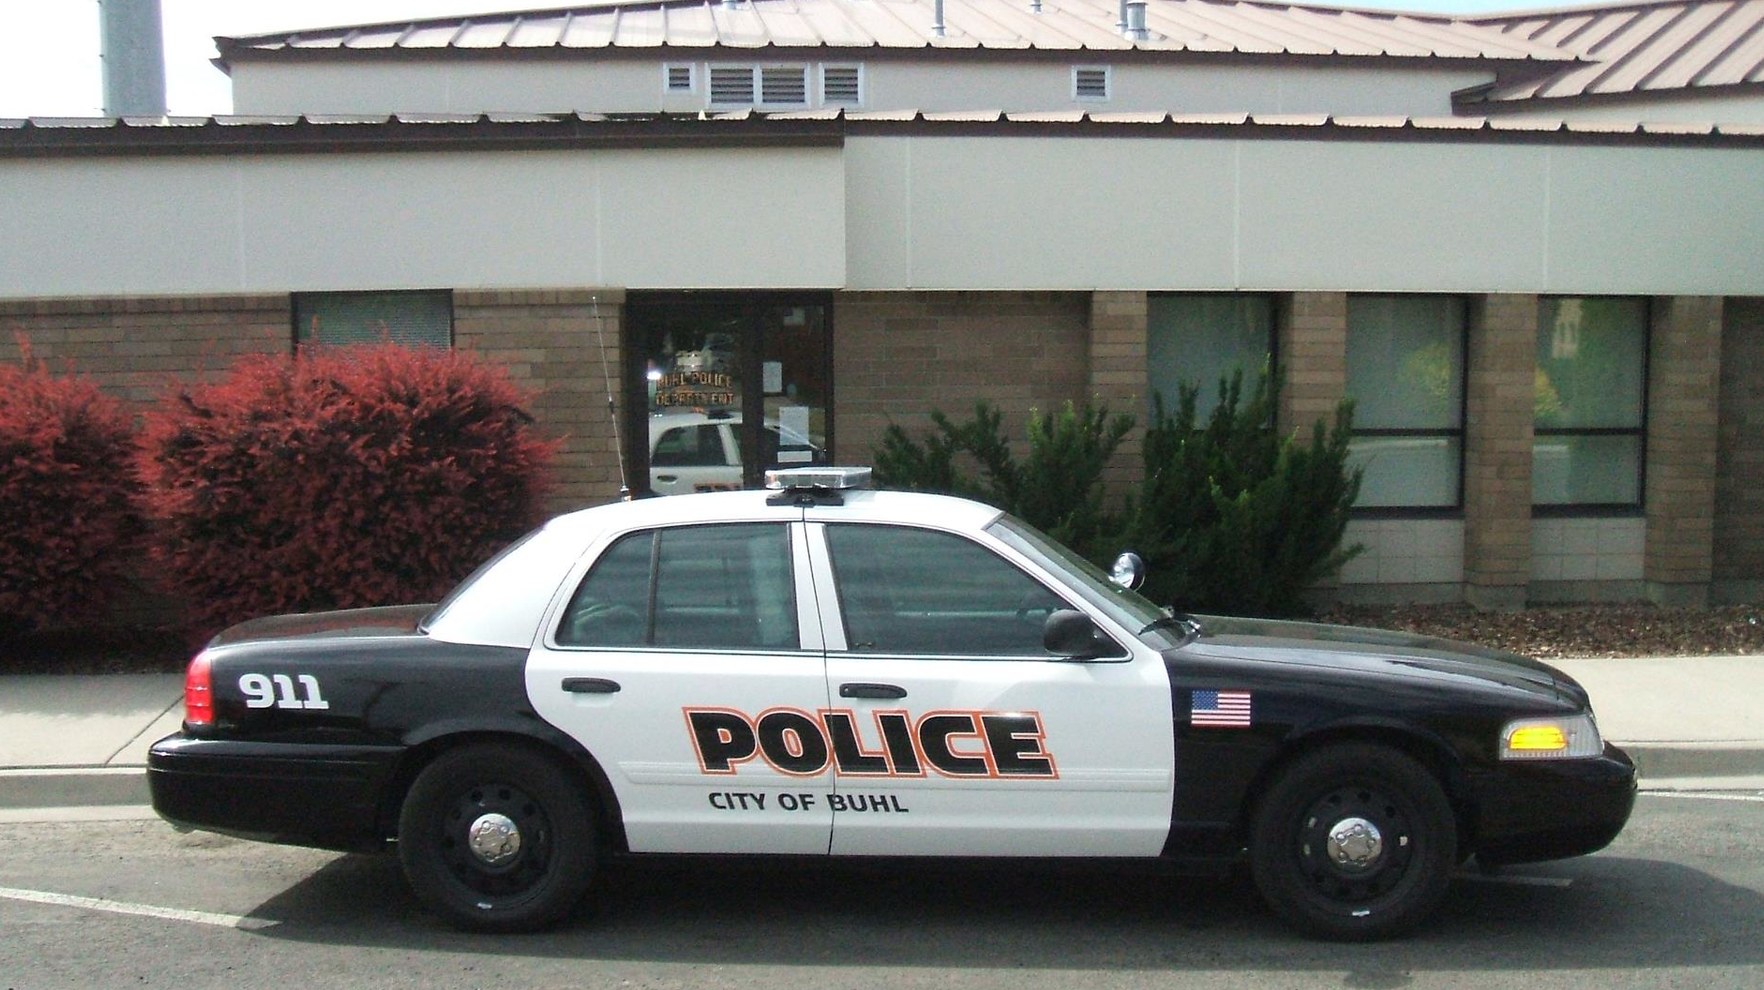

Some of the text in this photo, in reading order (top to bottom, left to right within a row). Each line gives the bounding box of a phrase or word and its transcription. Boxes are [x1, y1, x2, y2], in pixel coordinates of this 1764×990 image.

[692, 371, 732, 388] POLICE
[239, 673, 330, 710] 911
[682, 706, 1060, 780] POLICE
[708, 792, 910, 813] CITY OF BUHL
